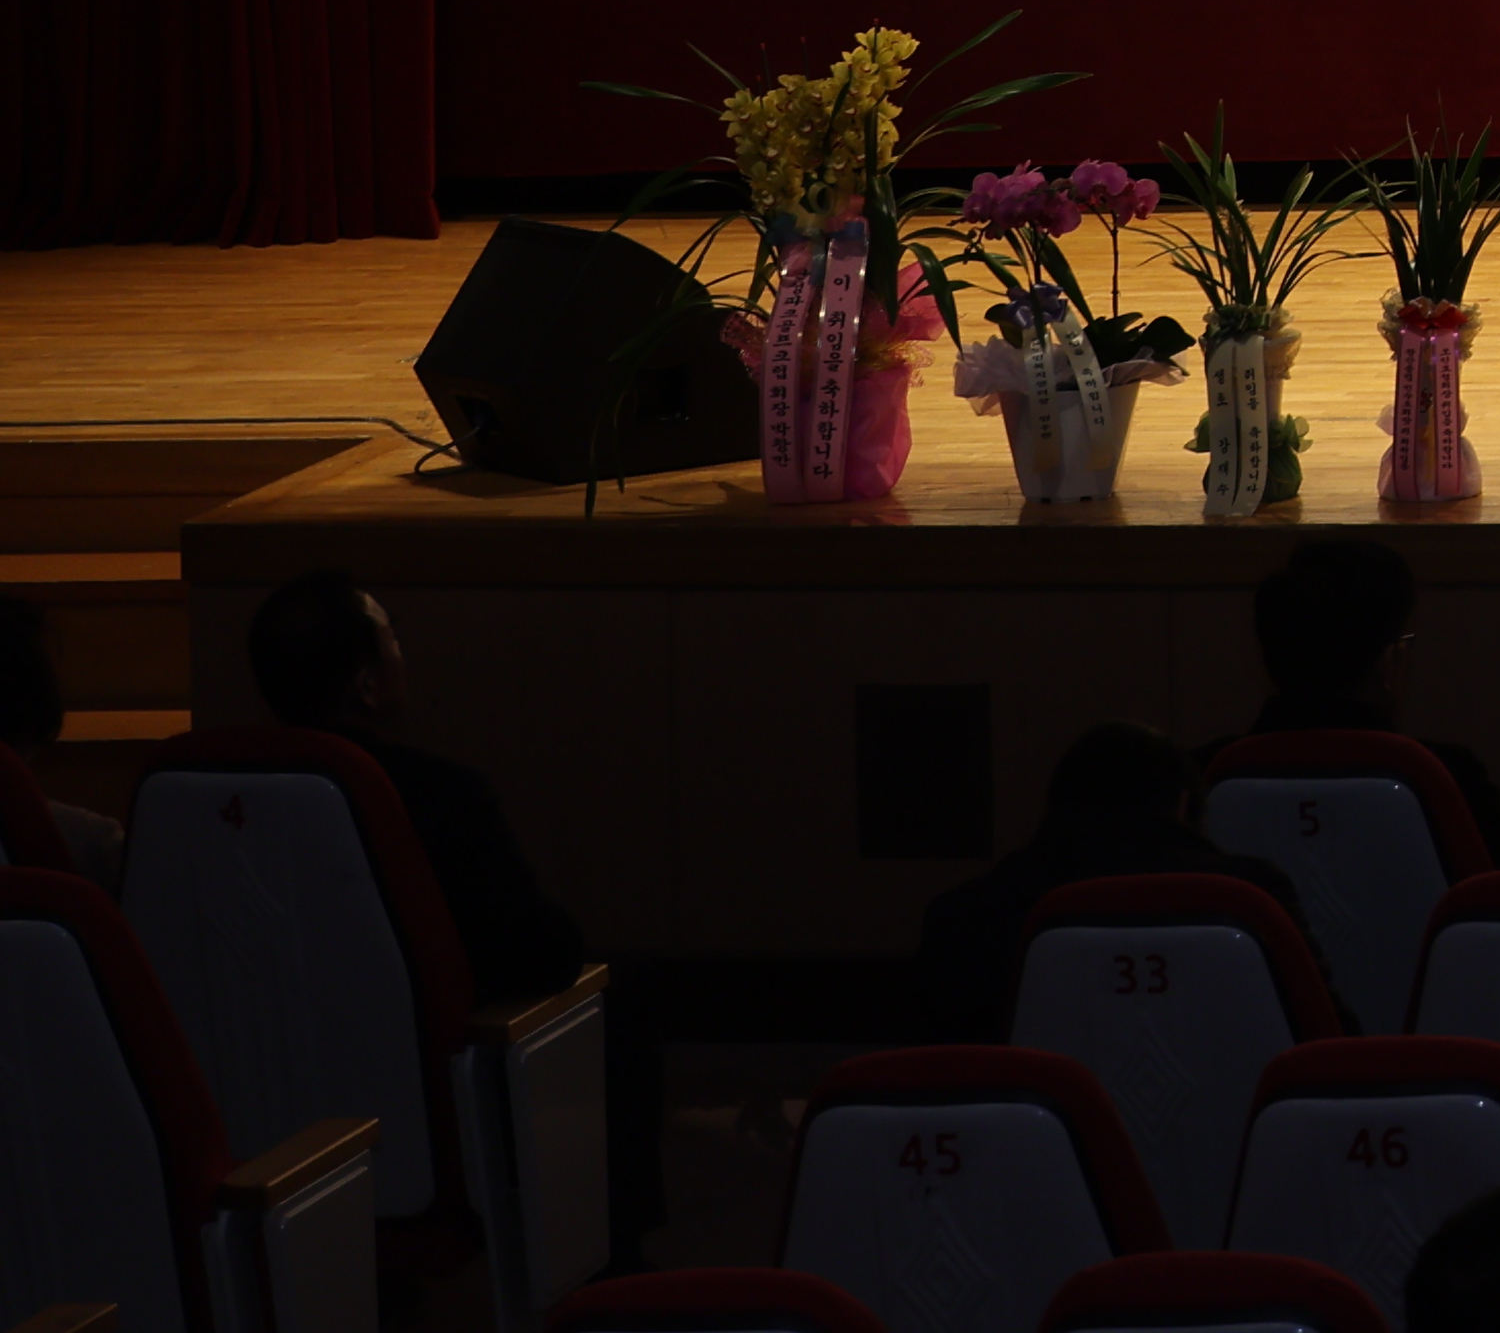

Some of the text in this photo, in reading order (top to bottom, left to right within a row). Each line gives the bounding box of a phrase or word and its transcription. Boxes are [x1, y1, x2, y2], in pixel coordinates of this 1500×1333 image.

[813, 379, 840, 480] 축하합니다
[218, 795, 246, 830] 4
[1299, 801, 1320, 837] 5
[1114, 954, 1169, 994] 33
[898, 1133, 962, 1176] 45
[1347, 1126, 1408, 1169] 46
